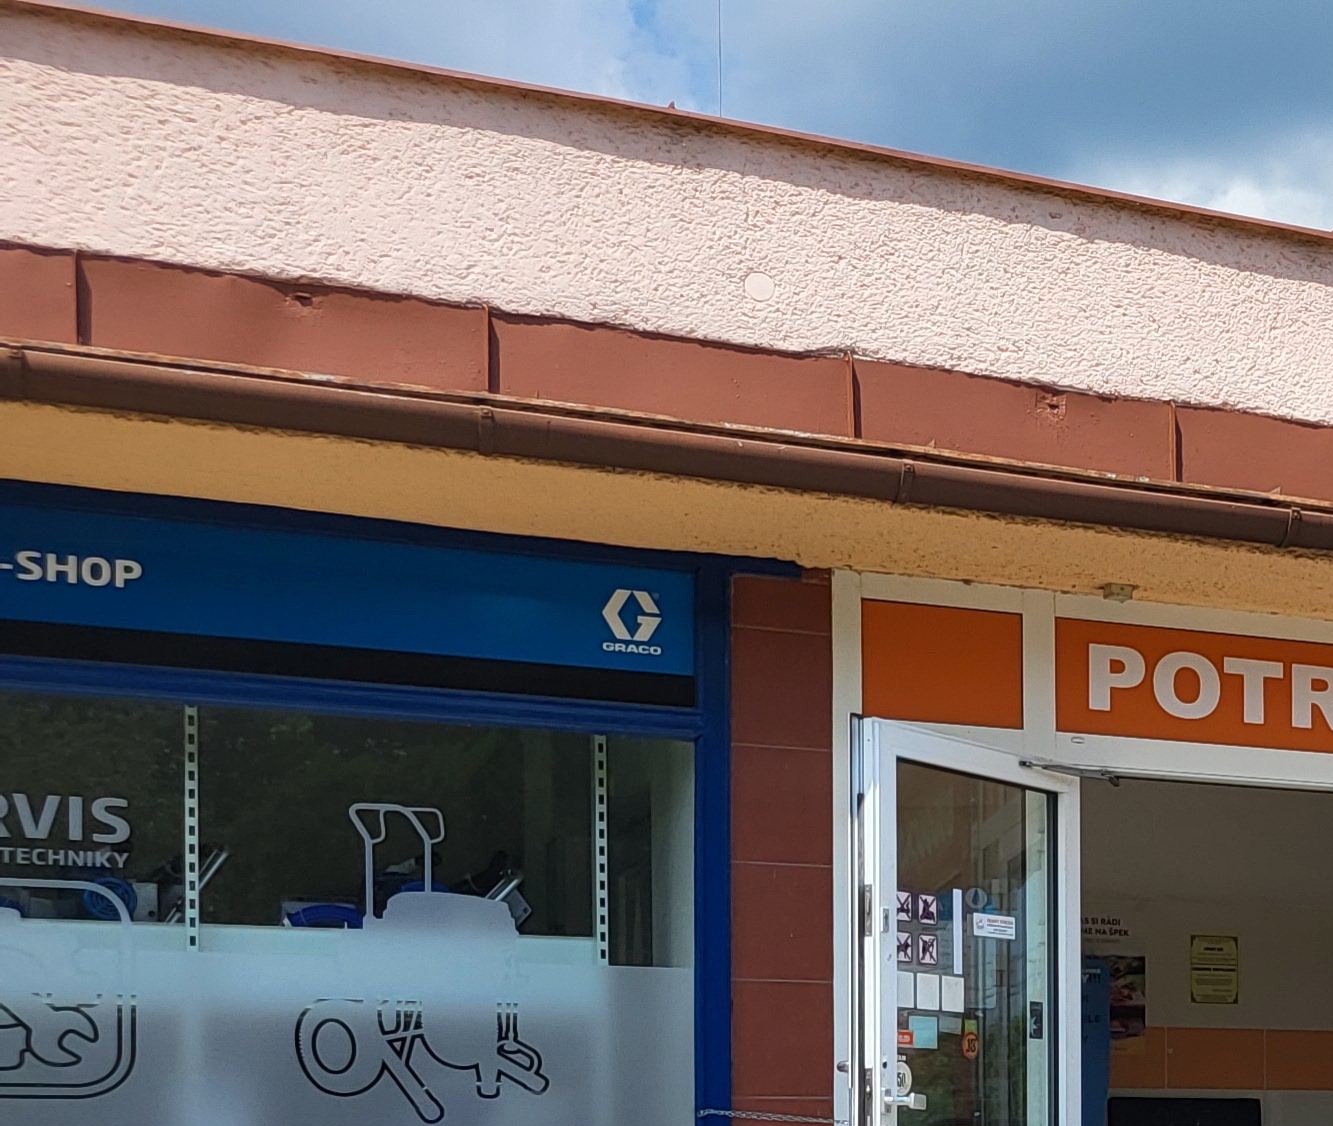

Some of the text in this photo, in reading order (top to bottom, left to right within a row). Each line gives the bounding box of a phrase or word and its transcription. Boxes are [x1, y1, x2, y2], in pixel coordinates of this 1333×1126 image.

[602, 641, 662, 656] GRACO
[0, 846, 129, 869] TECHNIKY
[1095, 928, 1107, 936] NA
[1109, 926, 1129, 937] ŠPEK
